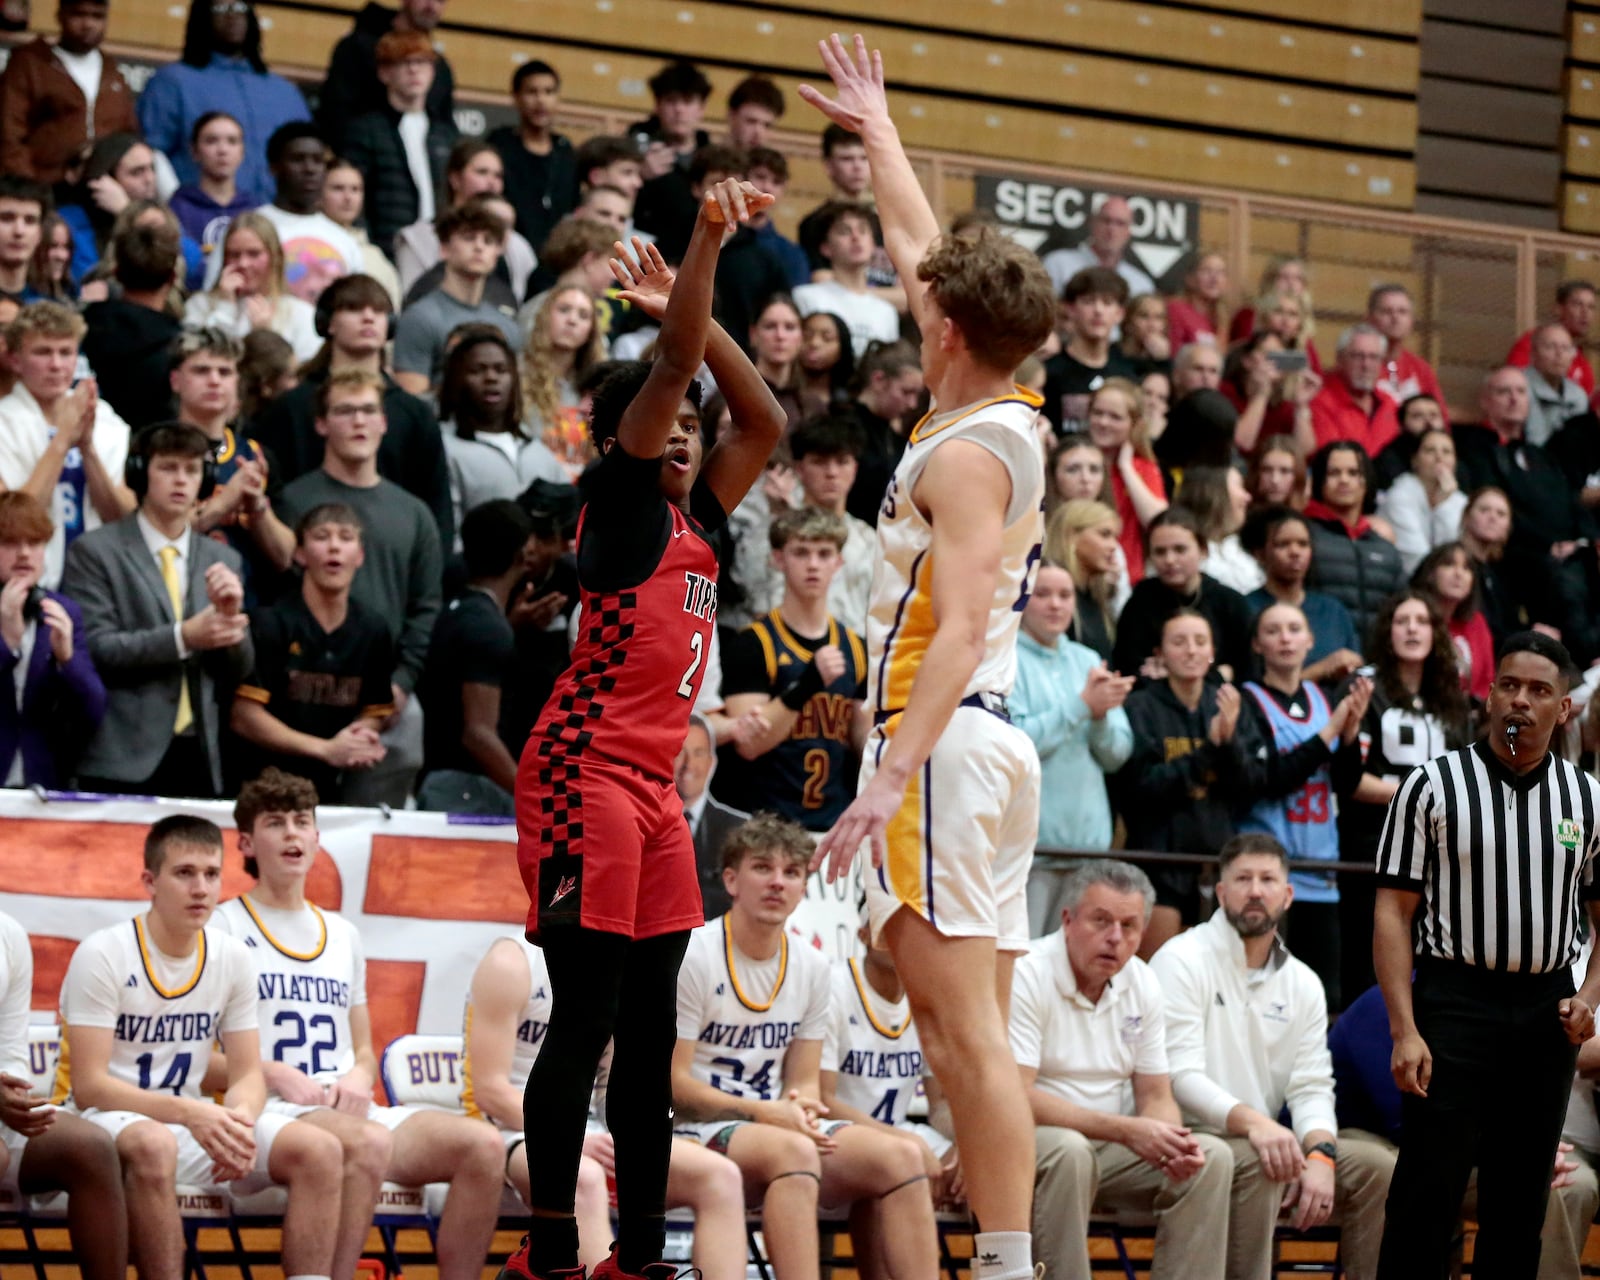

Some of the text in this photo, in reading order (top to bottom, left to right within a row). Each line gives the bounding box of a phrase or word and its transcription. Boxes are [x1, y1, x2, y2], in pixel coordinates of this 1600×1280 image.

[677, 631, 703, 699] 2
[802, 748, 830, 809] 2
[114, 1011, 220, 1044] AVIATOR
[273, 1011, 338, 1076] 22
[135, 1052, 192, 1096] 14
[870, 1088, 899, 1126] 4
